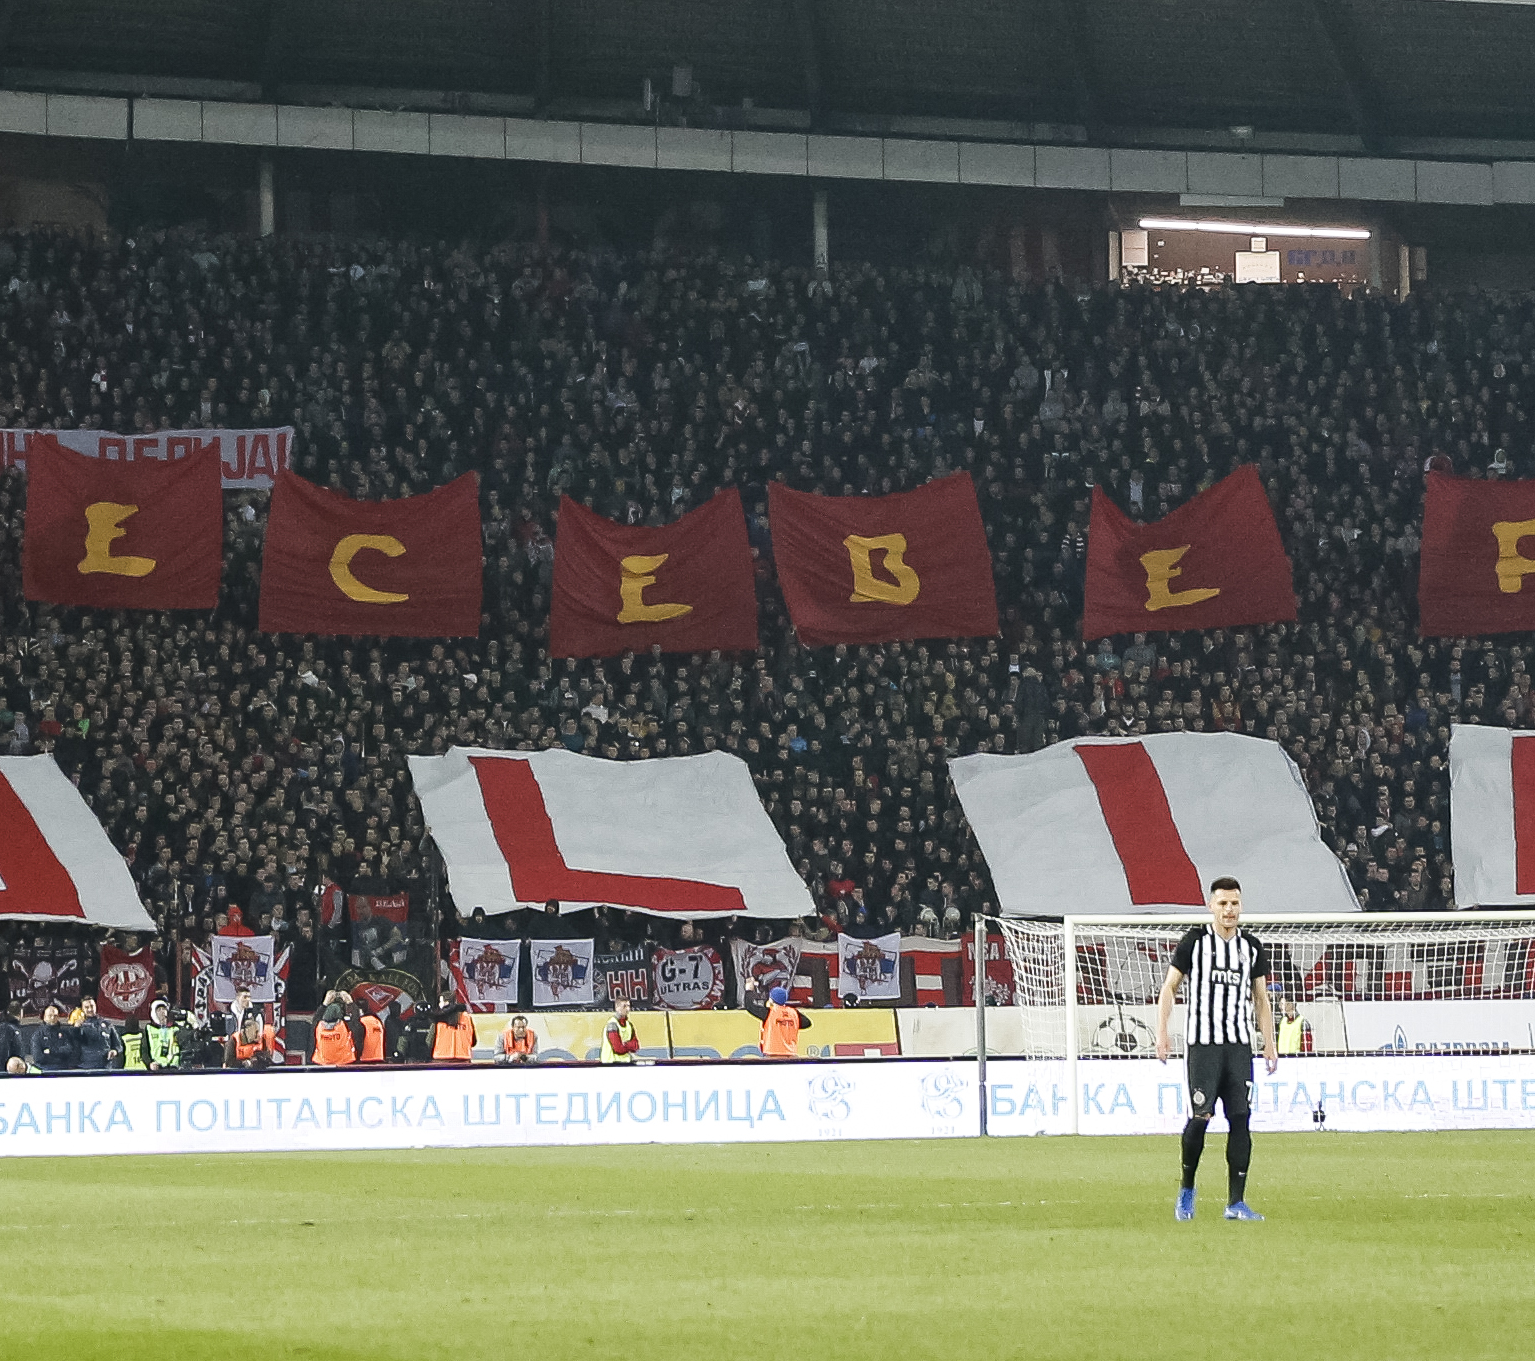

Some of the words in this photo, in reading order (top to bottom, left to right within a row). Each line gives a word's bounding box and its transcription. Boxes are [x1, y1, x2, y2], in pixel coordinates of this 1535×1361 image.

[661, 954, 703, 983] G-7
[1211, 969, 1241, 984] mts
[660, 981, 709, 995] ULTRAS
[156, 1094, 445, 1132] ПОШТАНСКА
[462, 1089, 786, 1128] ШТЕДИОНИЦА
[1158, 1079, 1434, 1114] ПТАНСКА
